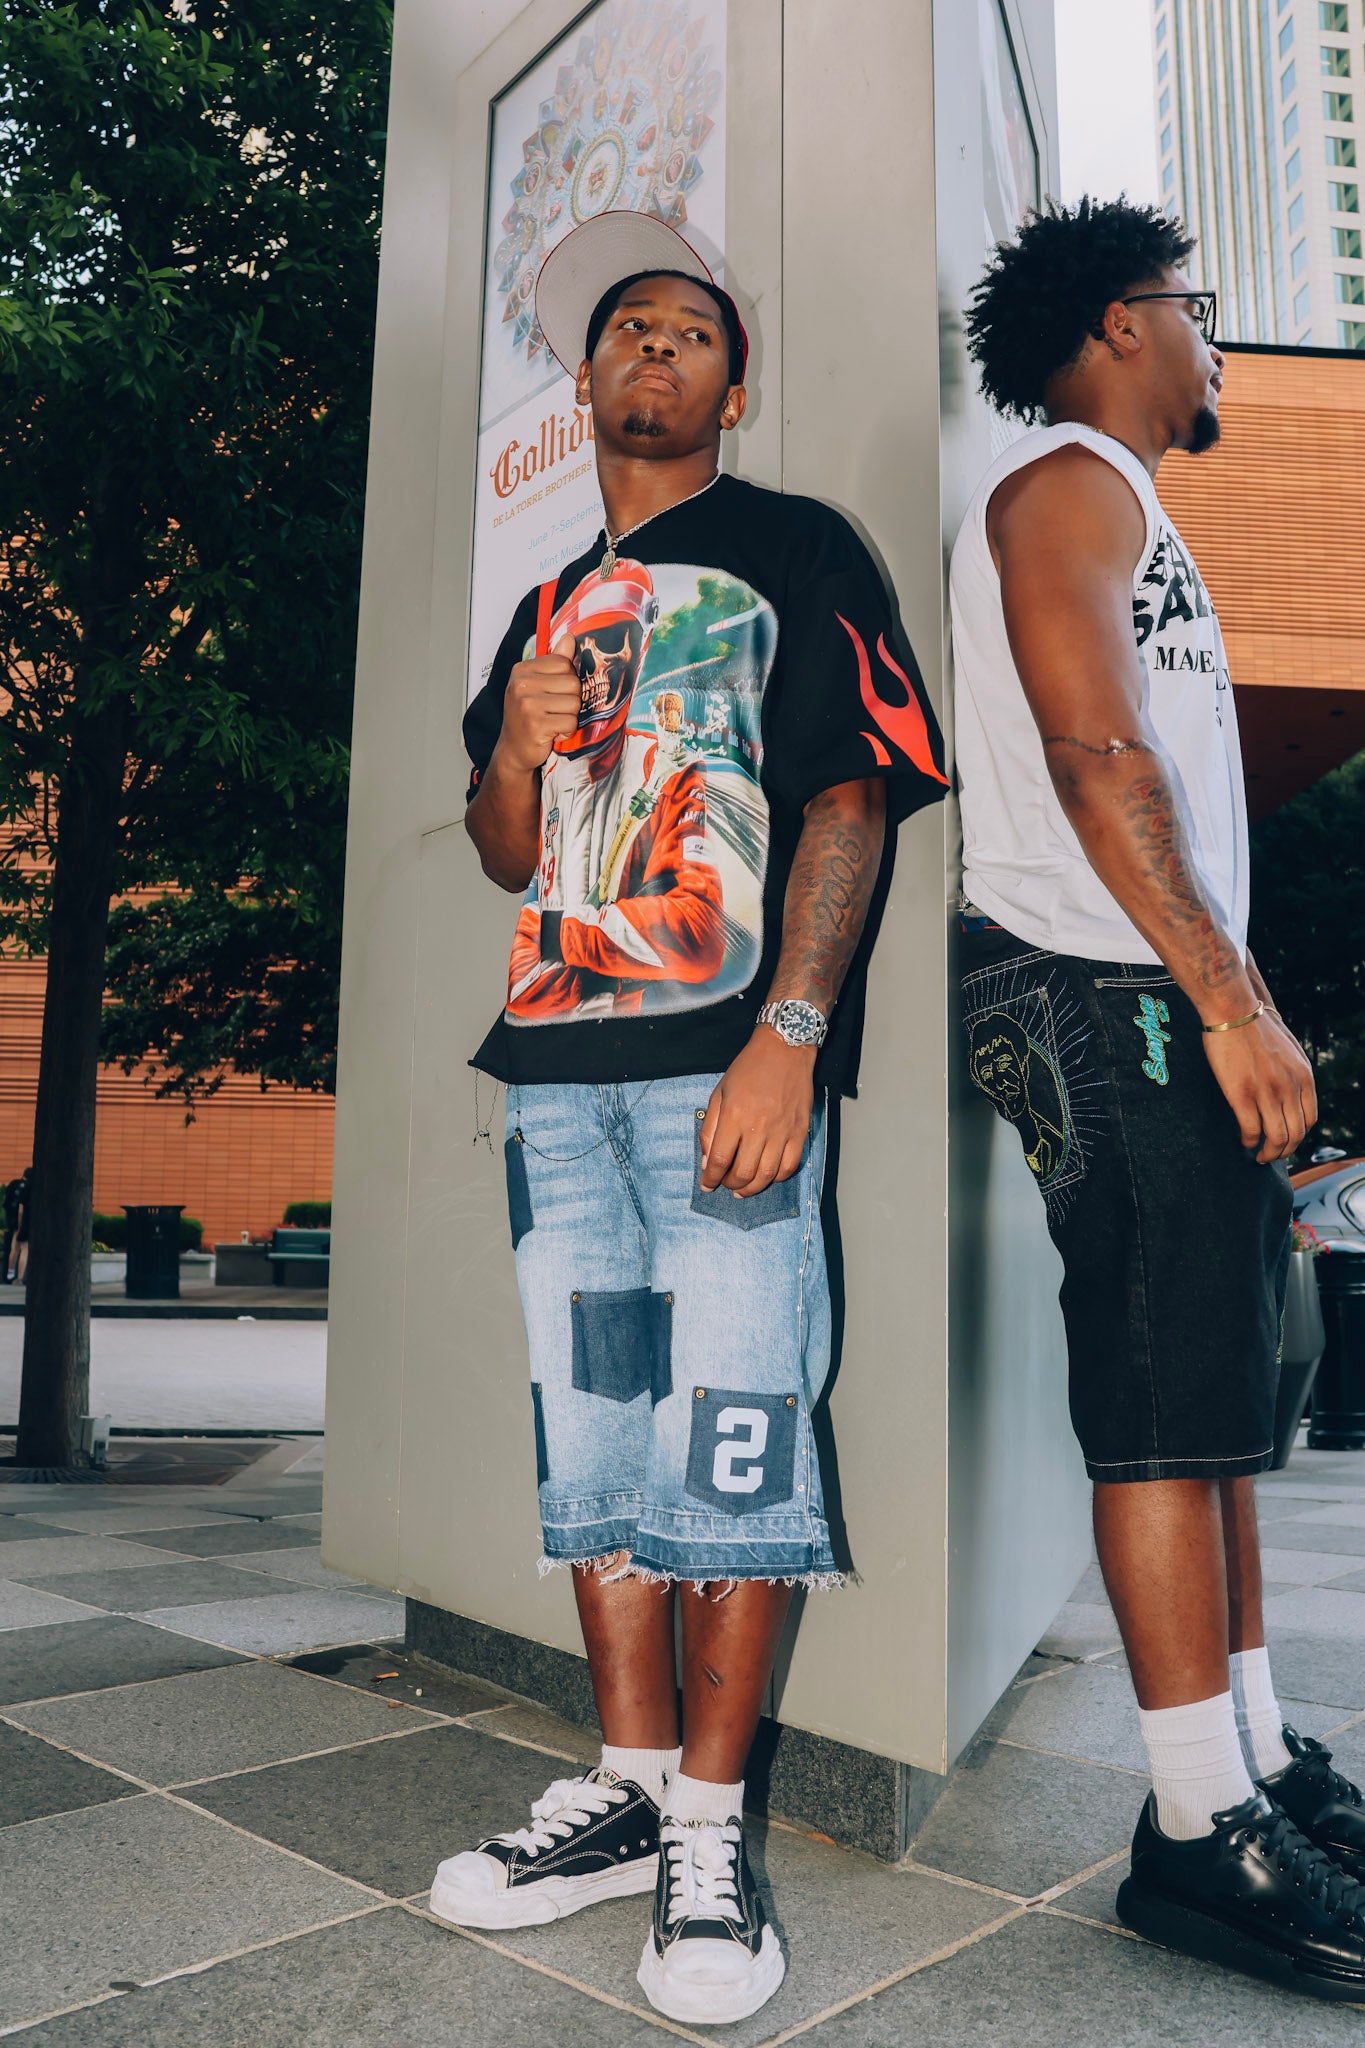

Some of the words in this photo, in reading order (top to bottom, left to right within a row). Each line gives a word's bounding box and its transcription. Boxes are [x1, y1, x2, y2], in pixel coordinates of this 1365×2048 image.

[493, 514, 504, 528] DE
[505, 508, 515, 521] LA
[516, 490, 543, 514] TORRE
[545, 459, 592, 496] BROTHERS
[528, 532, 548, 550] June
[539, 554, 560, 573] Mint
[712, 1406, 769, 1494] 2
